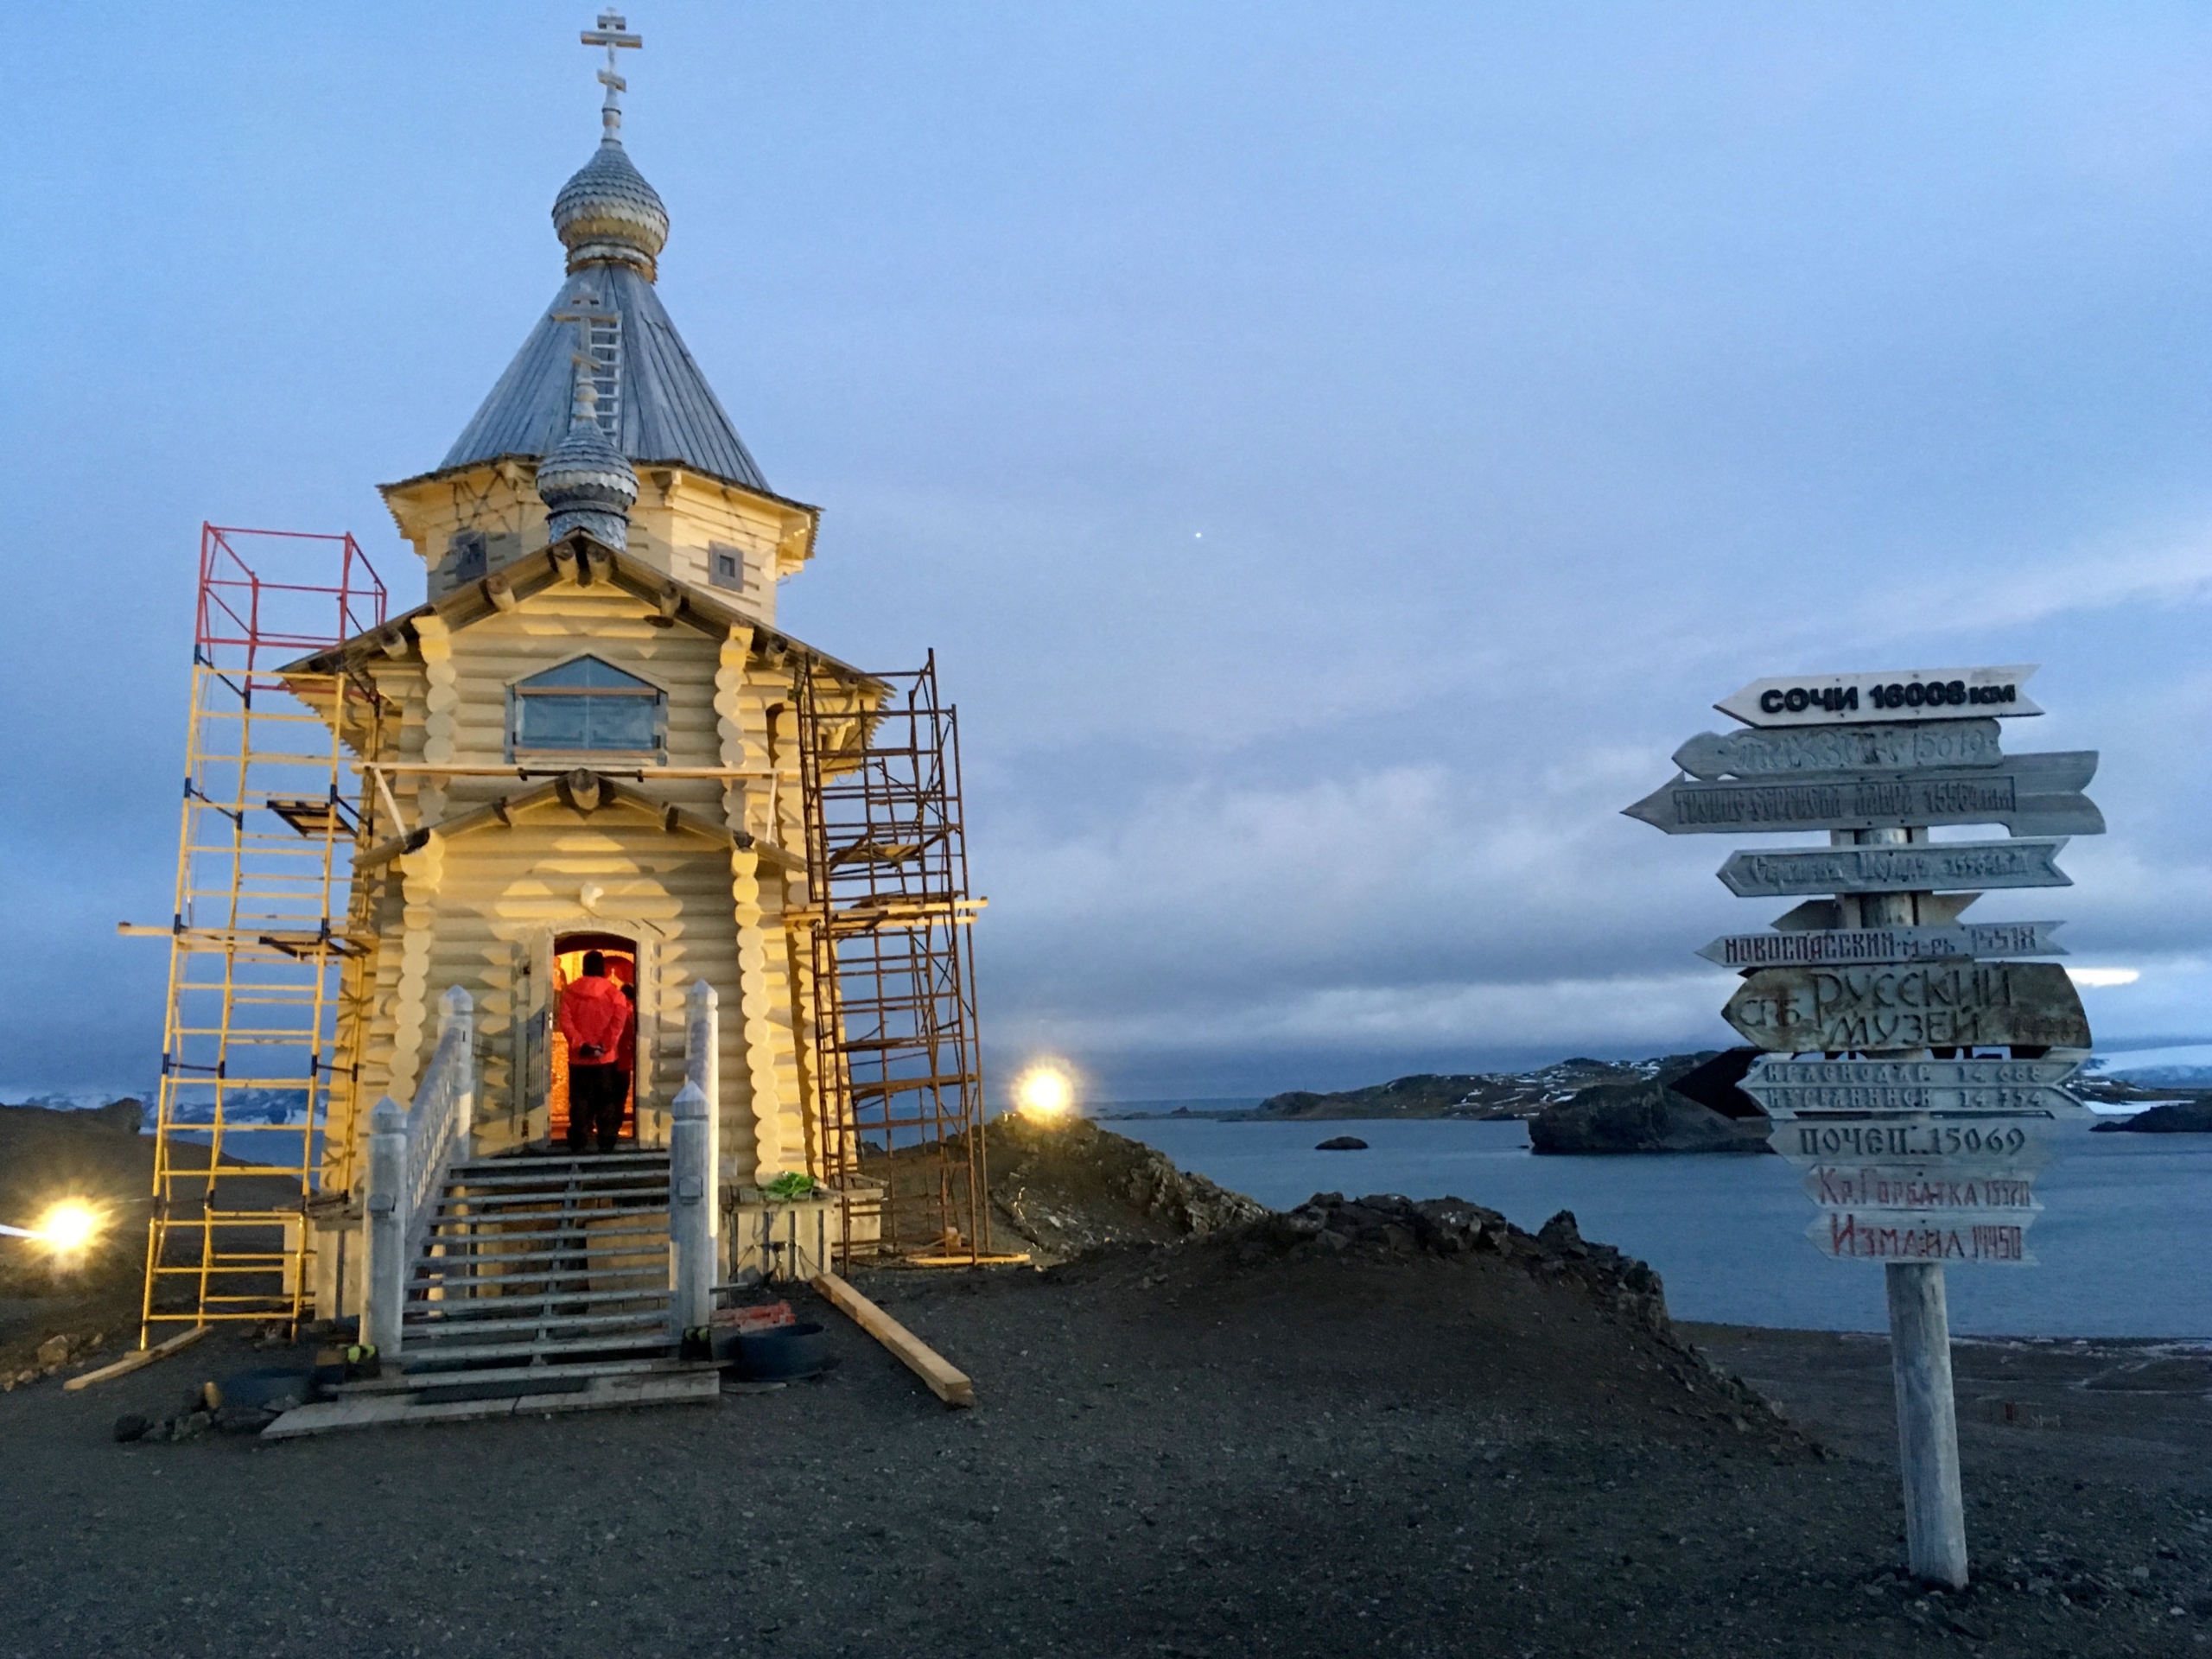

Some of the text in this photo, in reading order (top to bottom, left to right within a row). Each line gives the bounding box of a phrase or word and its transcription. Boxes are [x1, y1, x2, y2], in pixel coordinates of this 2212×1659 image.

[1760, 685, 1859, 714] СОЧИ
[1869, 680, 1966, 709] 16008
[1735, 997, 1801, 1028] СПБ
[1827, 1004, 1980, 1046] МУЗЕЙ
[1767, 1064, 1930, 1084] КРАСНОДАР
